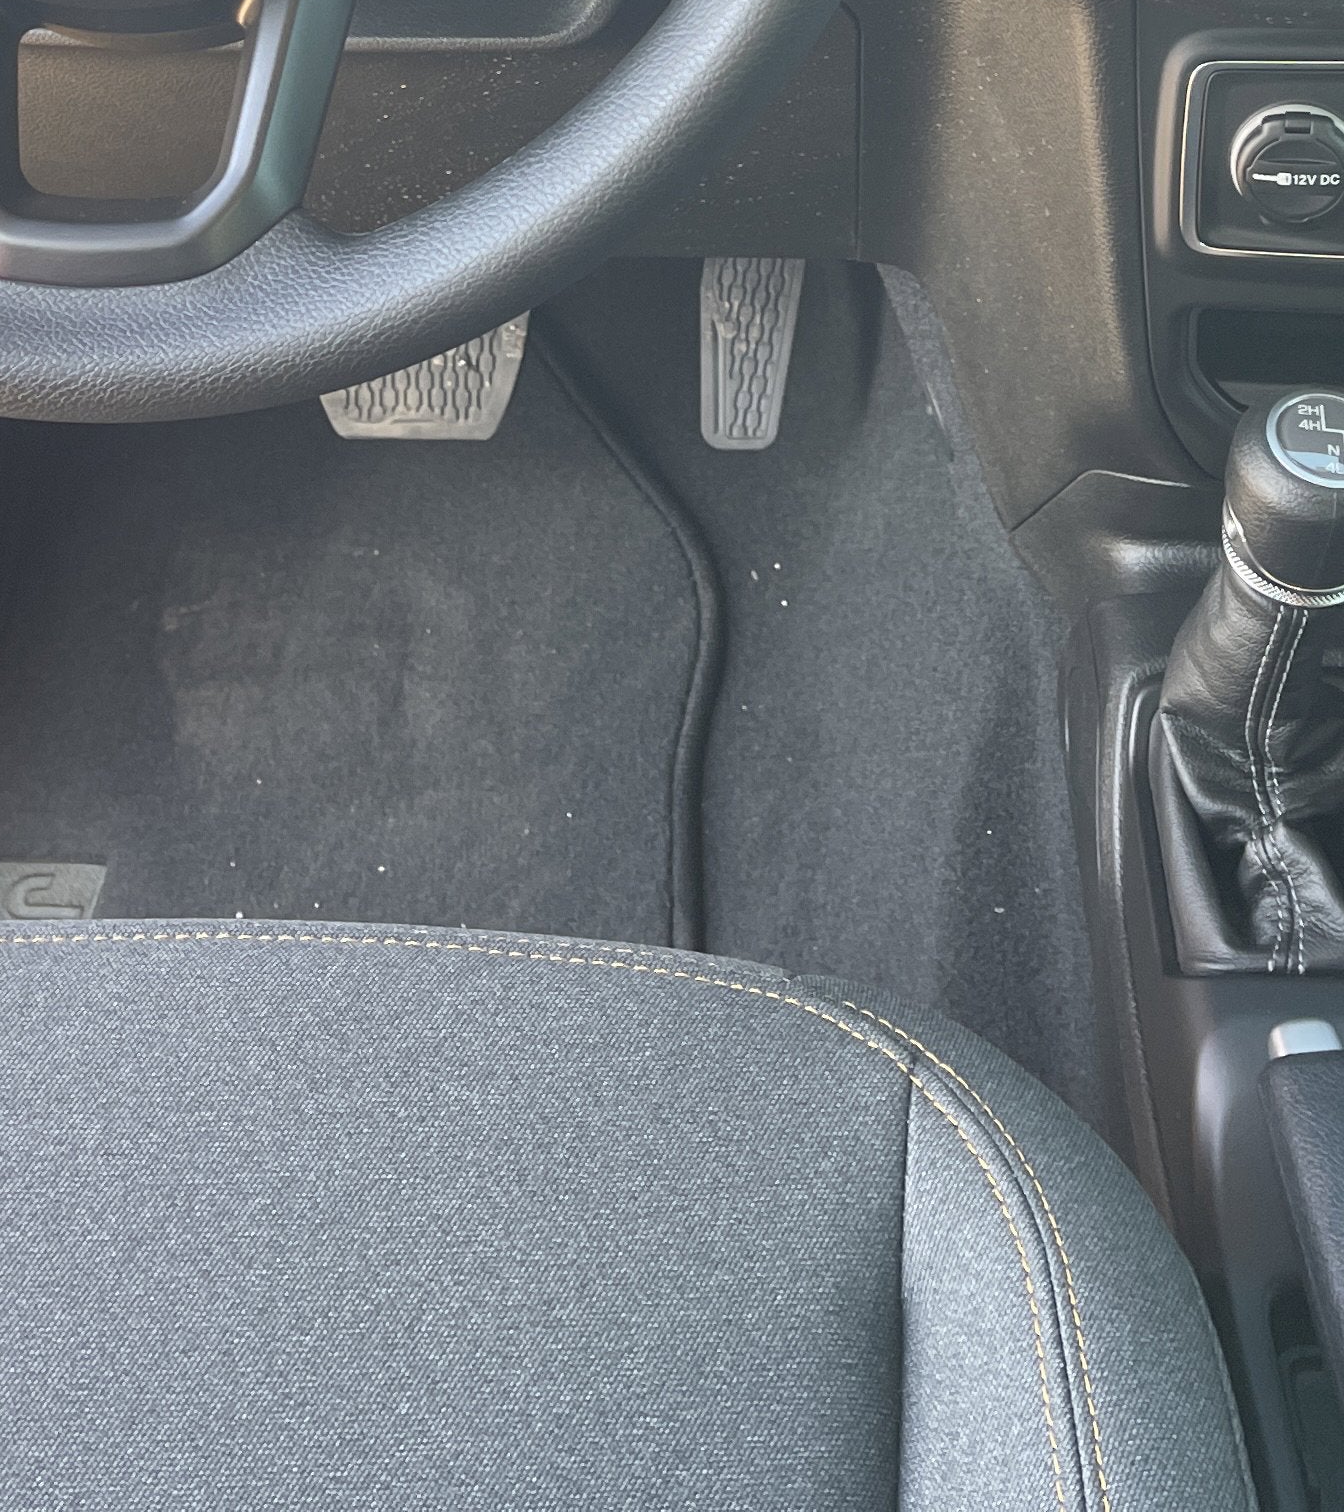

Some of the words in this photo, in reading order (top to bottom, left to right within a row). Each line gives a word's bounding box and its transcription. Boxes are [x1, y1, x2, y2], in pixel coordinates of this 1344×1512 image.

[1292, 174, 1318, 186] 12V
[1319, 173, 1341, 186] DC
[1297, 404, 1320, 416] 2H
[1298, 419, 1321, 431] 4H
[1327, 443, 1341, 456] N
